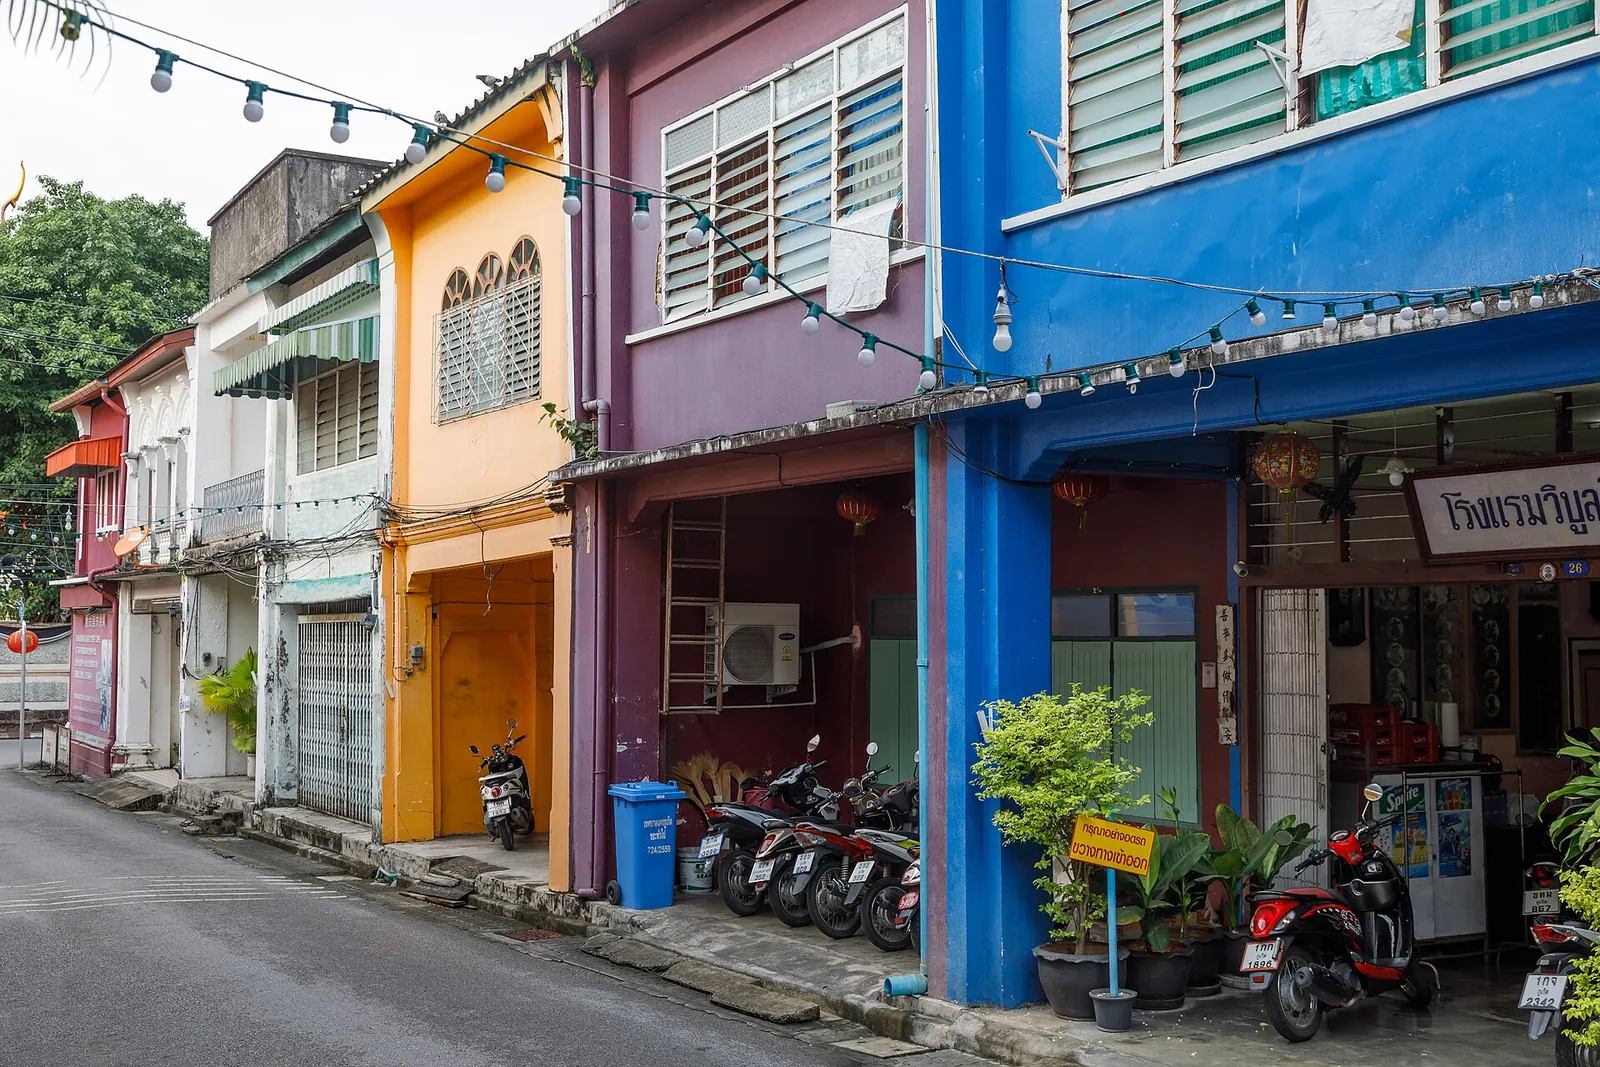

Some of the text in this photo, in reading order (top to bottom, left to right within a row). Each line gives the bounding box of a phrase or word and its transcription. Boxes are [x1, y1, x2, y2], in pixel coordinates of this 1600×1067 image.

[1568, 562, 1583, 575] 26
[1072, 841, 1148, 870] ขวางทางเข้าออก
[1531, 905, 1551, 913] 867
[1248, 960, 1273, 969] 1896
[1526, 997, 1555, 1007] 2342
